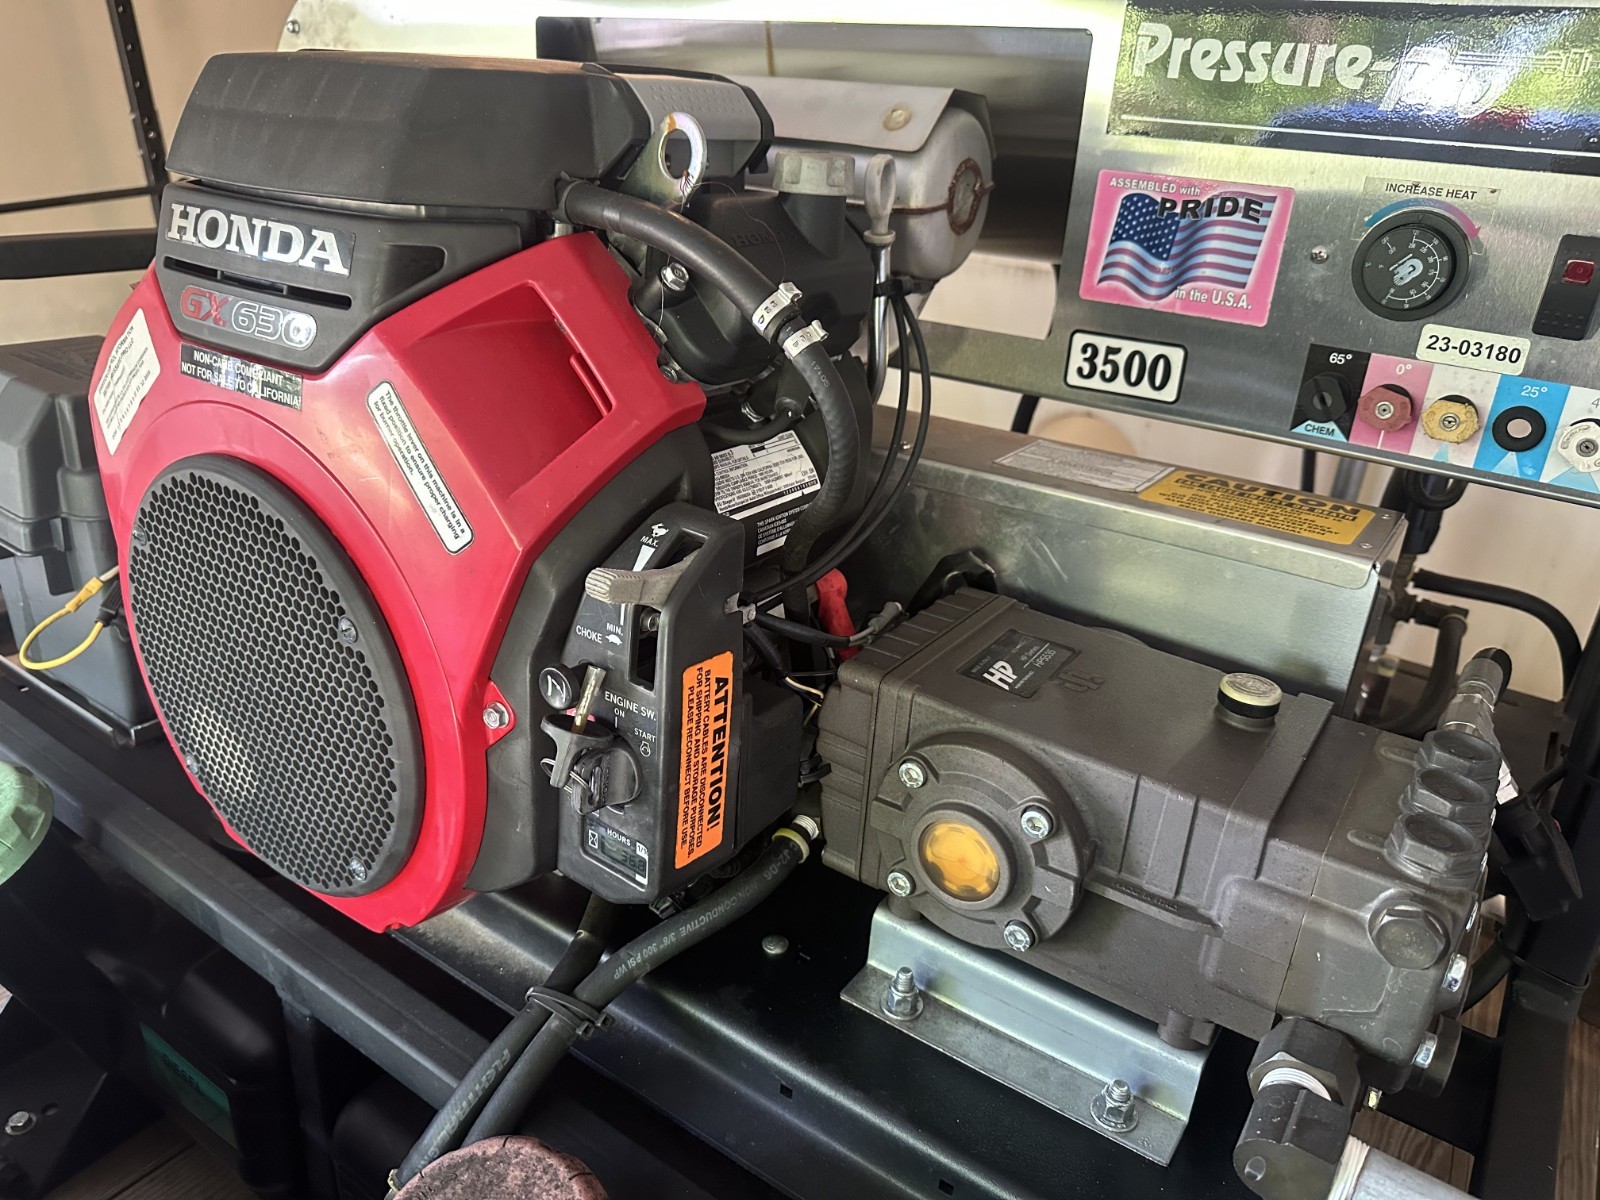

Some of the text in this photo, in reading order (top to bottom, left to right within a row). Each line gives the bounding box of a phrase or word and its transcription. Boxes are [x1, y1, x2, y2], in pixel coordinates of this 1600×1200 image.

[1110, 177, 1201, 197] ASSEMBLED with
[1385, 183, 1478, 201] INCREASE HEAT
[1157, 197, 1264, 223] PRIDE
[166, 203, 348, 276] HONDA
[1175, 286, 1253, 310] in the U.S.A.
[182, 286, 317, 349] GX 630
[1329, 352, 1353, 365] 65°
[1426, 334, 1522, 364] 23-03180
[193, 350, 284, 386] NON-CARB COMPLIANT
[1076, 342, 1172, 392] 3500
[1396, 363, 1412, 376] 0°
[181, 362, 301, 410] NOT FOR SALE TO CALIFORNIA
[1521, 385, 1548, 399] 25°
[373, 400, 414, 476] for burner operation.
[1304, 422, 1335, 437] CHEM
[379, 395, 460, 540] fixed position to ensure proper charging
[385, 390, 394, 406] The
[392, 405, 409, 434] throttle
[406, 433, 419, 453] lever
[417, 451, 426, 464] on
[423, 463, 434, 480] this
[431, 479, 452, 511] machine
[455, 516, 462, 528] in
[1184, 473, 1360, 515] CAUTION
[1311, 508, 1356, 521] DEATH
[640, 534, 659, 549] MAX.
[575, 624, 603, 645] CHOKE
[606, 622, 624, 636] MIN.
[982, 660, 1018, 691] HP
[604, 689, 657, 722] ENGINE SW.
[613, 707, 625, 718] ON
[634, 727, 657, 743] START
[687, 665, 704, 858] FOR SHIPPING AND STORAGE PURPOSES.
[695, 668, 713, 849] BATTERY CABLES ARE DISCONNECTED
[704, 675, 730, 832] ATTENTION!
[680, 684, 695, 850] PLEASE RECONNECT BEFORE USE.
[607, 828, 631, 846] HOURS
[679, 896, 738, 937] CONDUCTIVE
[642, 943, 658, 958] 300
[659, 931, 677, 949] 3/8"
[613, 964, 627, 980] WP
[627, 955, 642, 969] PSI
